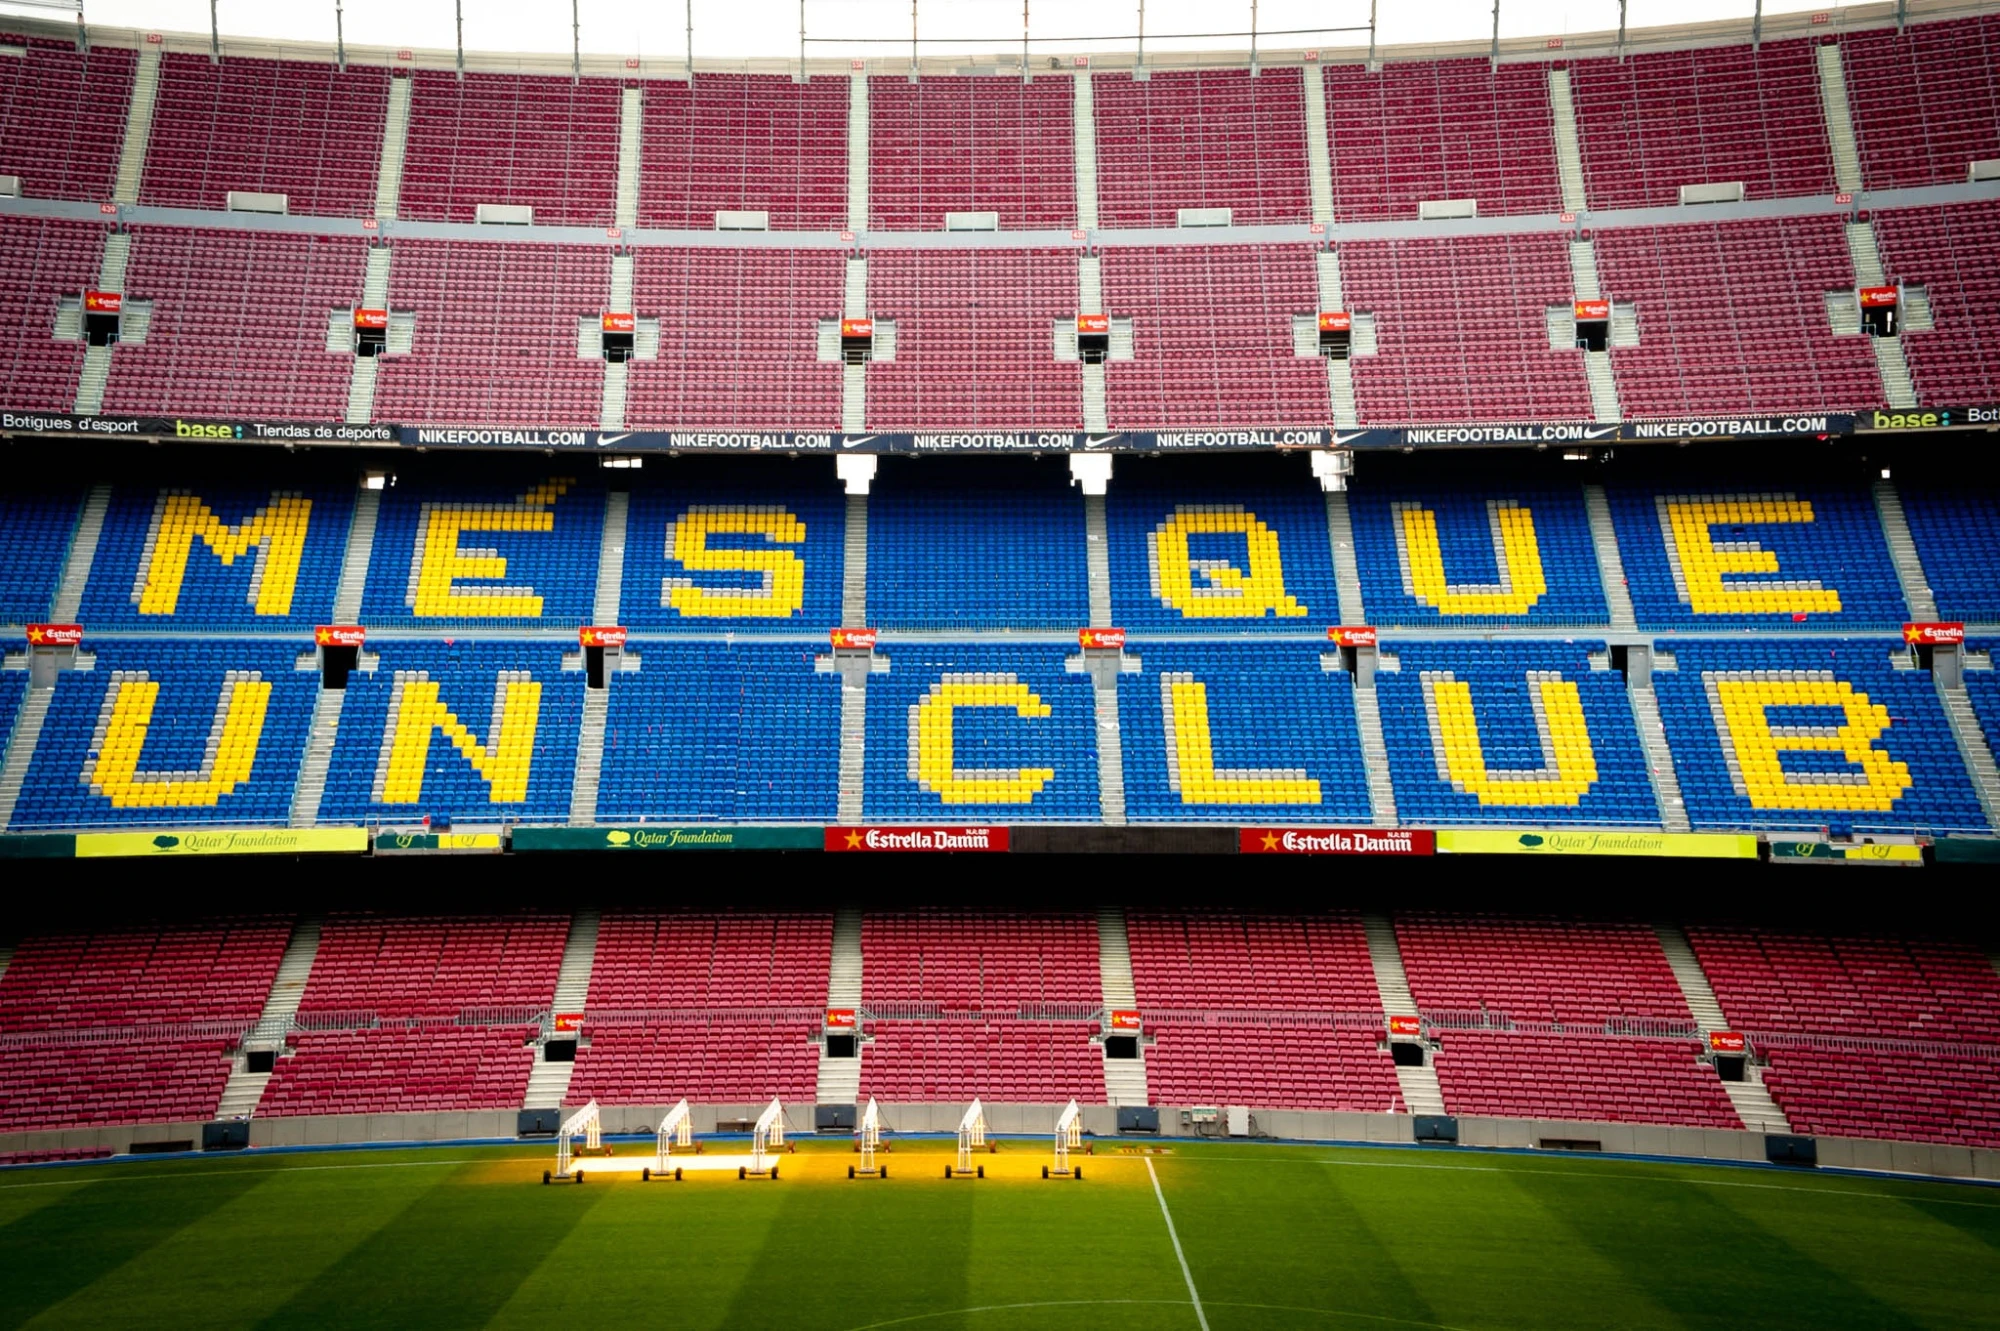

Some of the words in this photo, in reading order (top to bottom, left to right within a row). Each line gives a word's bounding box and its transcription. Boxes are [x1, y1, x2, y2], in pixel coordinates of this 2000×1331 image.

[1836, 194, 1852, 203] 432
[101, 205, 116, 213] 439
[3, 414, 72, 431] Botigues
[79, 418, 139, 434] d'esport
[254, 423, 310, 437] Tiendas
[314, 425, 333, 437] de
[337, 426, 390, 440] deporte
[1636, 418, 1826, 437] NIKEFOOTBALL.COM
[419, 430, 585, 445] NIKEFOOTBALL.COM
[670, 434, 830, 448] NIKEFOOTBALL.COM
[914, 435, 1074, 448] NIKEFOOTBALL.COM
[1157, 432, 1321, 447] NIKEFOOTBALL.COM
[1407, 426, 1582, 443] NIKEFOOTBALL.COM
[131, 477, 808, 620] MÉS
[1146, 492, 1844, 620] QUE
[46, 629, 82, 640] Estrella
[331, 630, 365, 640] Estrella
[595, 631, 626, 641] Estrella
[846, 632, 876, 642] Estrella
[1094, 632, 1125, 642] Estrella
[1344, 630, 1375, 641] Estrella
[1924, 627, 1963, 638] Estrella
[80, 670, 543, 808] UN
[908, 670, 1914, 813] CLUB
[184, 835, 224, 851] Qatar
[224, 832, 297, 850] Foundation
[634, 830, 668, 847] Qatar
[667, 830, 733, 847] Foundation
[866, 829, 932, 849] Estrella
[933, 831, 989, 849] Damm
[1283, 831, 1351, 852] Estrella
[1353, 833, 1412, 852] Damm
[1549, 835, 1587, 851] Qatar
[1586, 834, 1663, 851] Foundation
